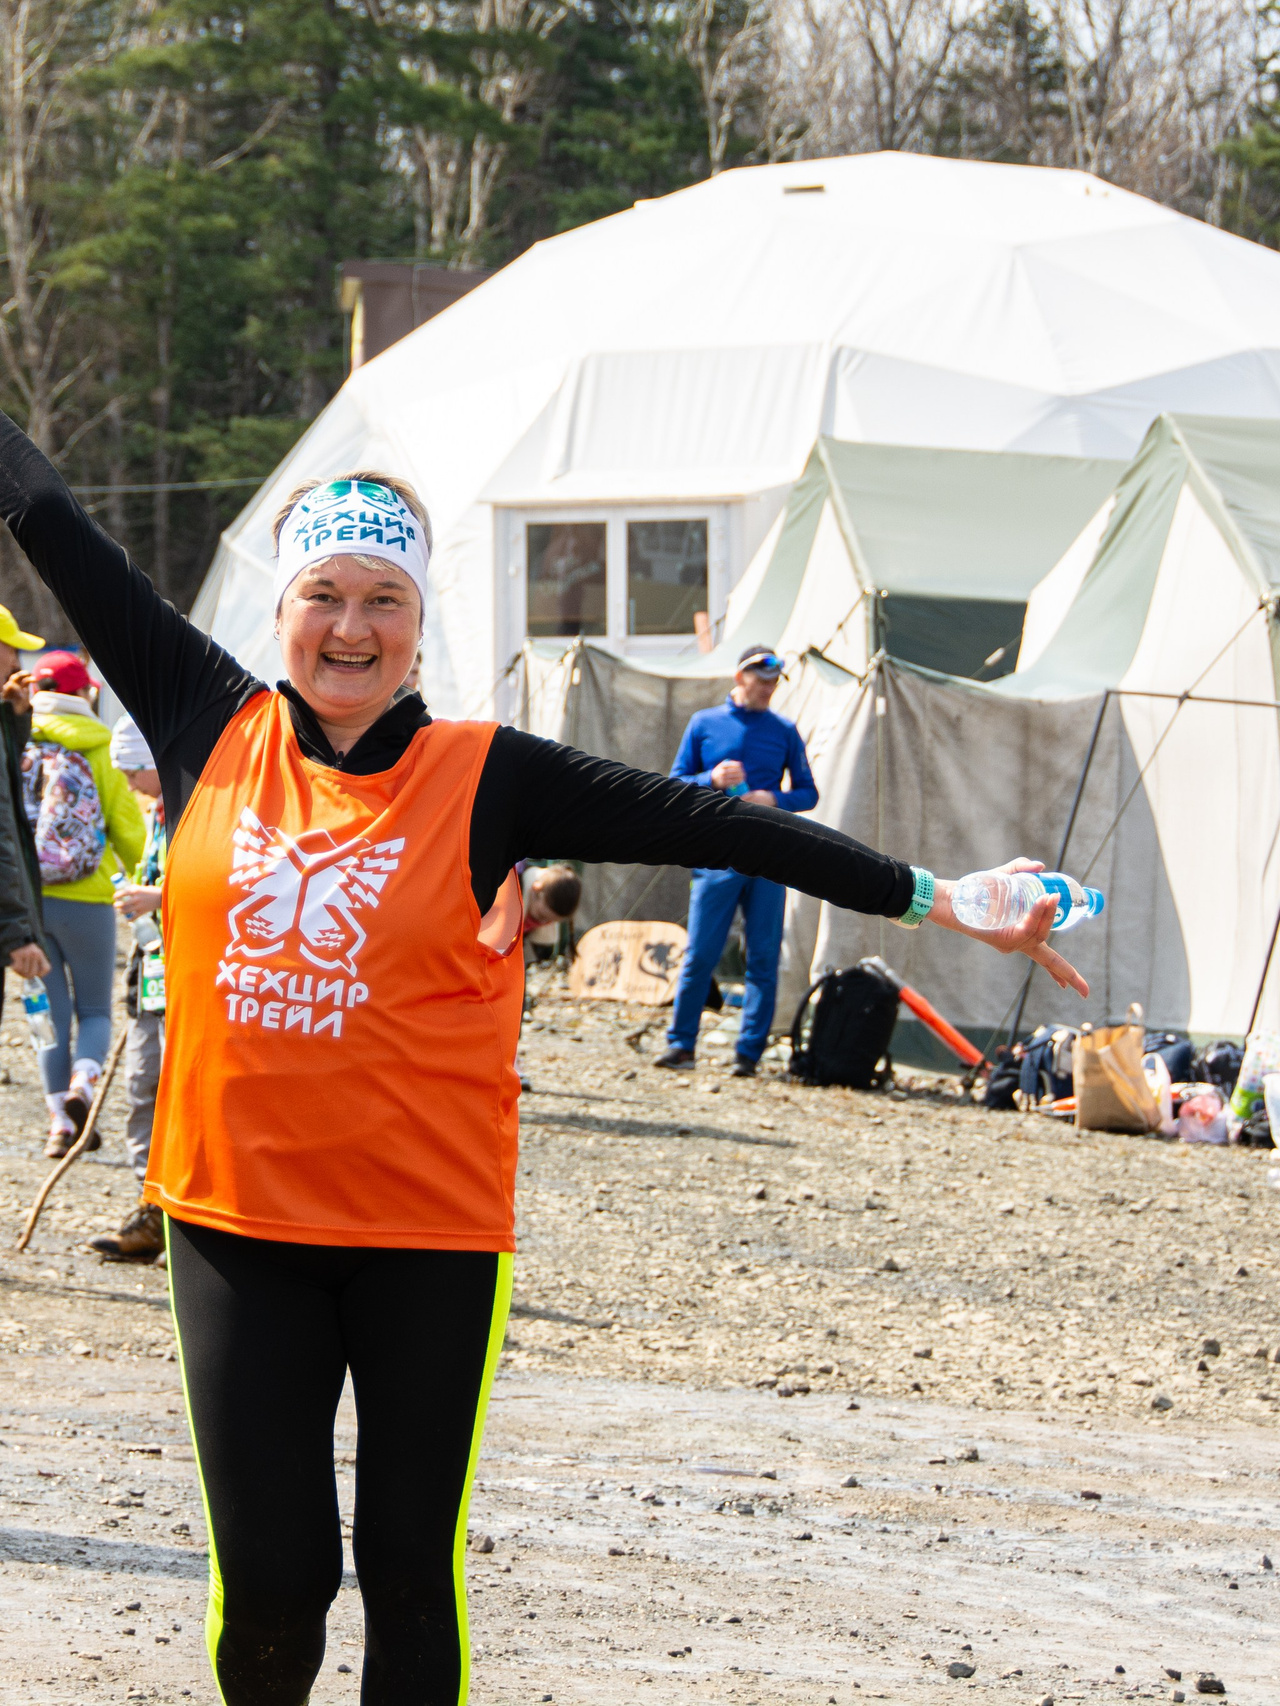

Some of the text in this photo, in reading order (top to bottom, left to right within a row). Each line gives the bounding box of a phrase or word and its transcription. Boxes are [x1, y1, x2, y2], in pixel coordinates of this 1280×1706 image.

[293, 510, 416, 543] ХЕХЦИР
[215, 960, 369, 1008] ХЕХЦИР
[225, 993, 343, 1037] ТРЕЙЛ
